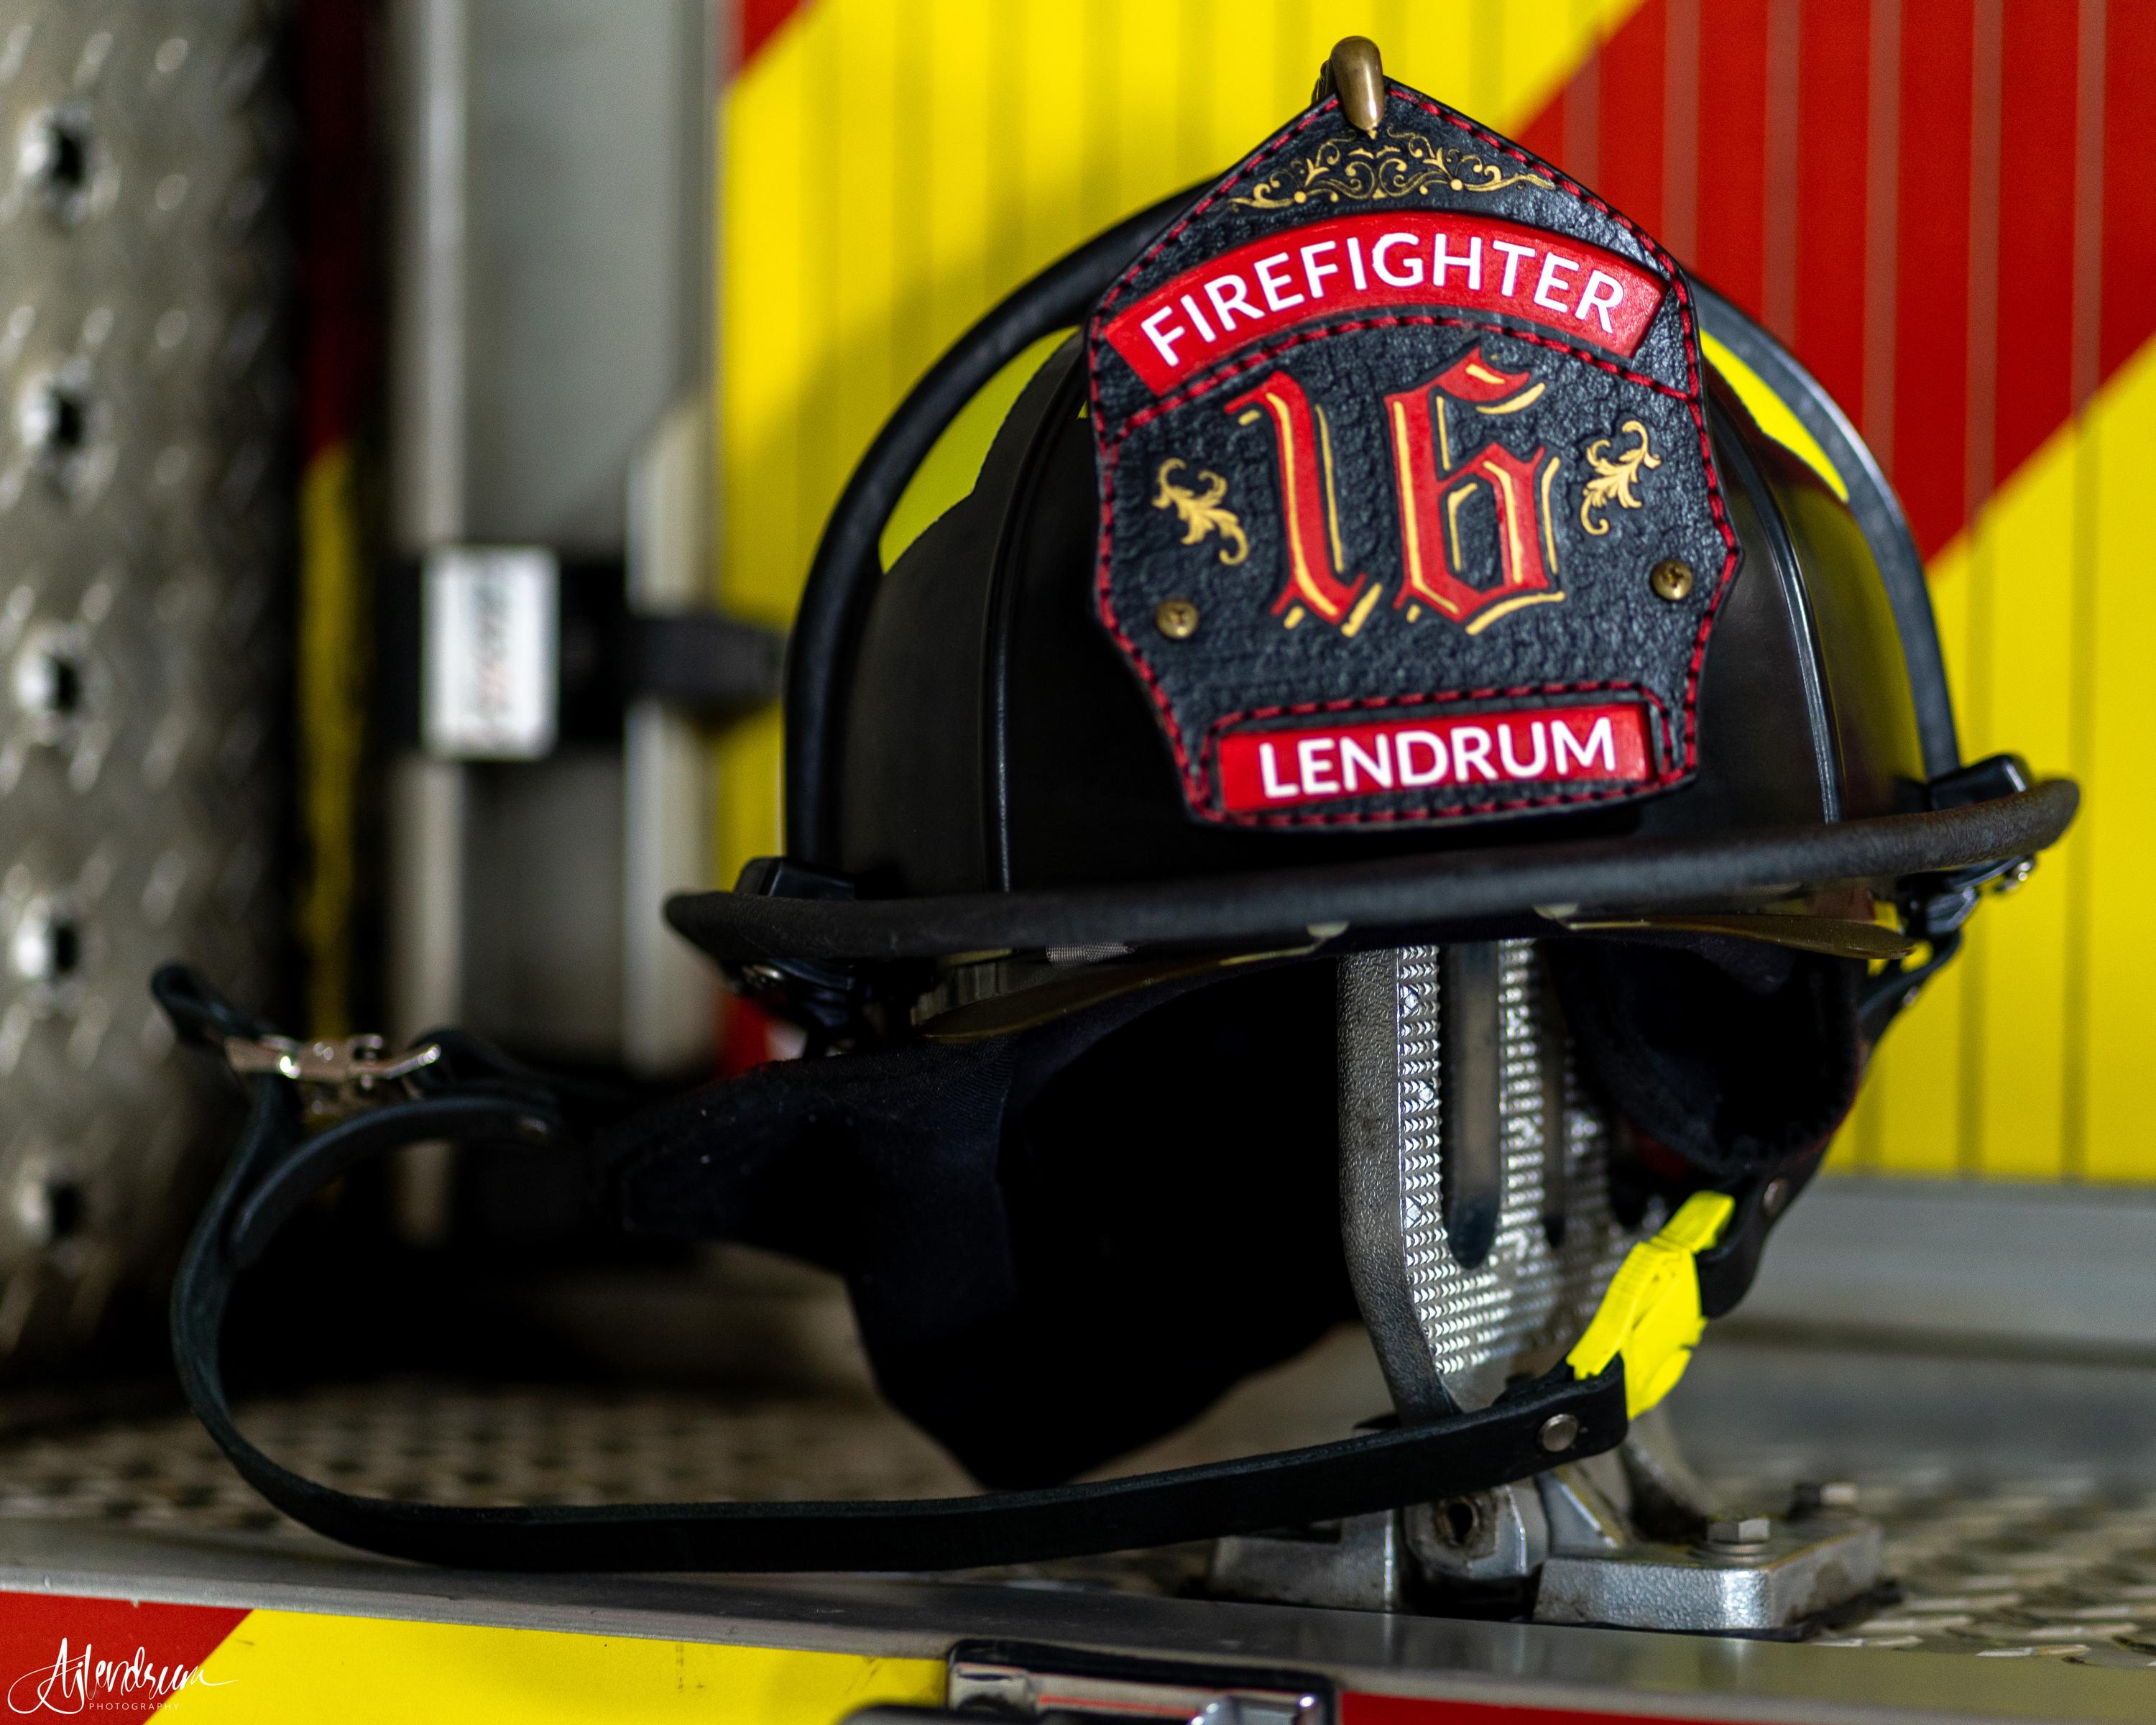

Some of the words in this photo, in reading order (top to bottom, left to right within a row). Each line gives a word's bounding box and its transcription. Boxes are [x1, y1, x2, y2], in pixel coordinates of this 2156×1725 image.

[1141, 233, 1626, 367] FIREFIGHTER
[1223, 347, 1565, 637] 16
[1259, 717, 1616, 799] LENDRUM
